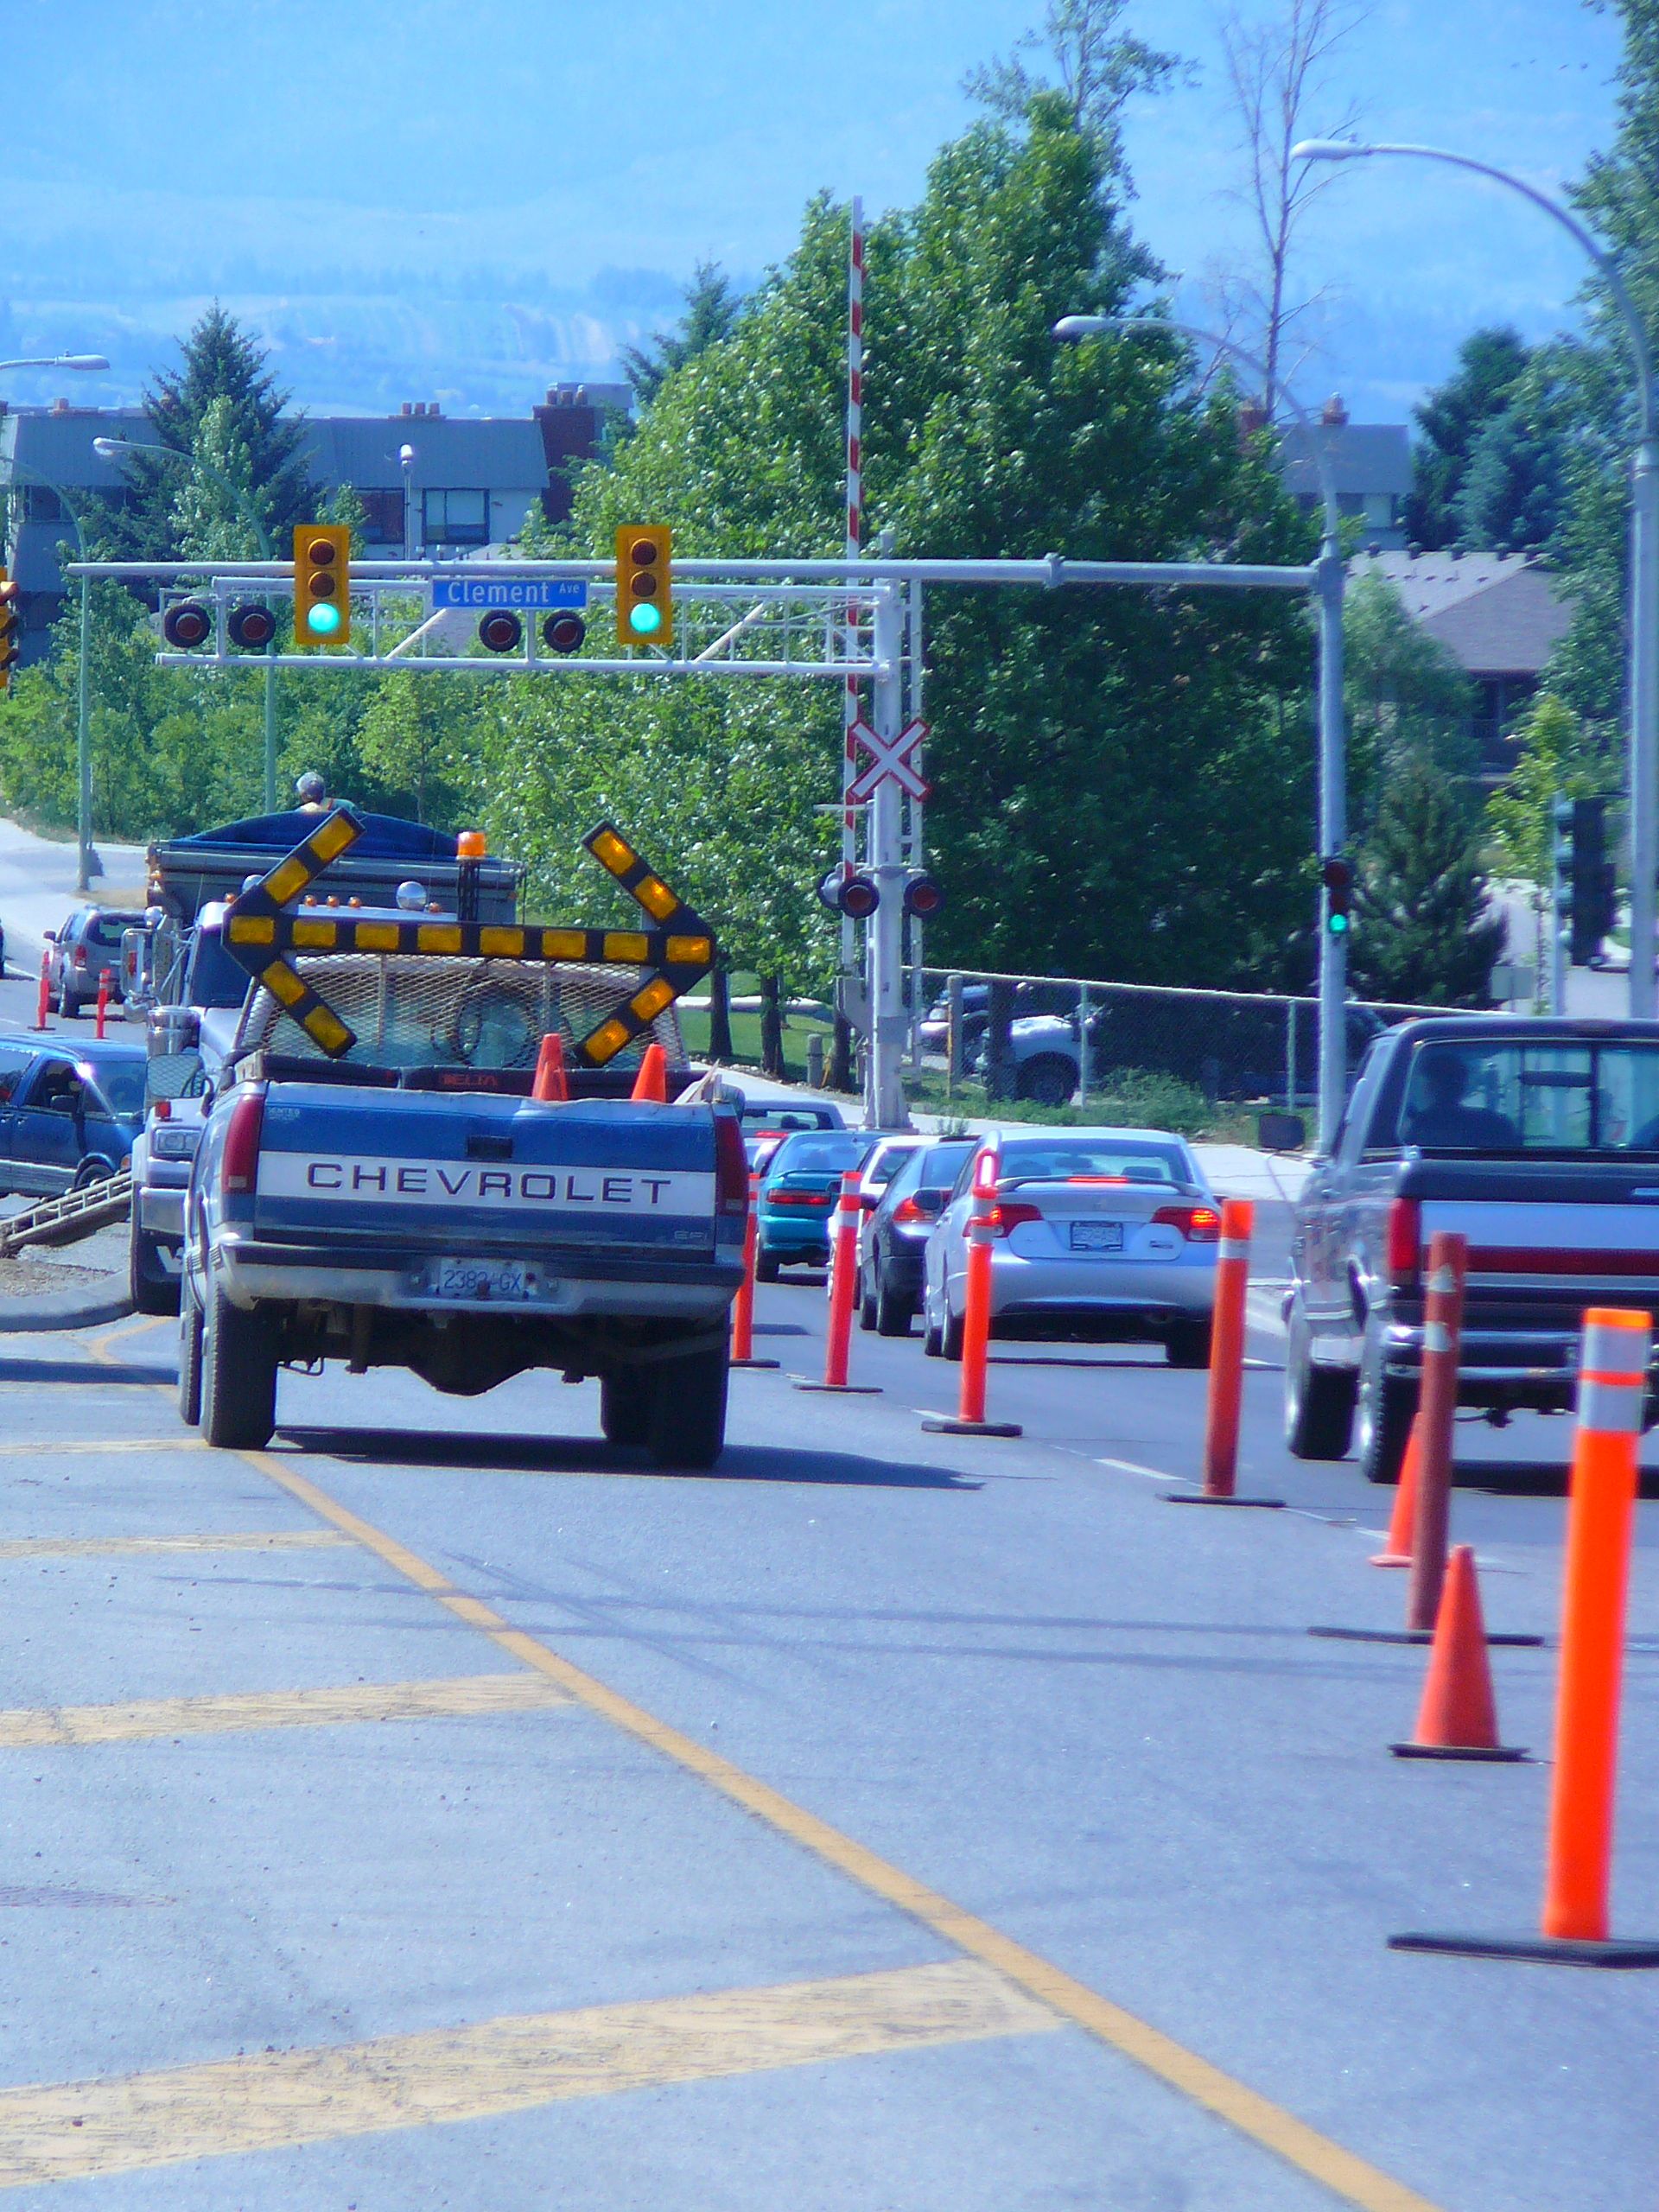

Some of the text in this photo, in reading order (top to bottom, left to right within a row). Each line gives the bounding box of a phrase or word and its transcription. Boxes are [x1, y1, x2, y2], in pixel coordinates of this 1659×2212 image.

[448, 581, 580, 603] Clement Ave
[307, 1162, 671, 1205] CHEVROLET
